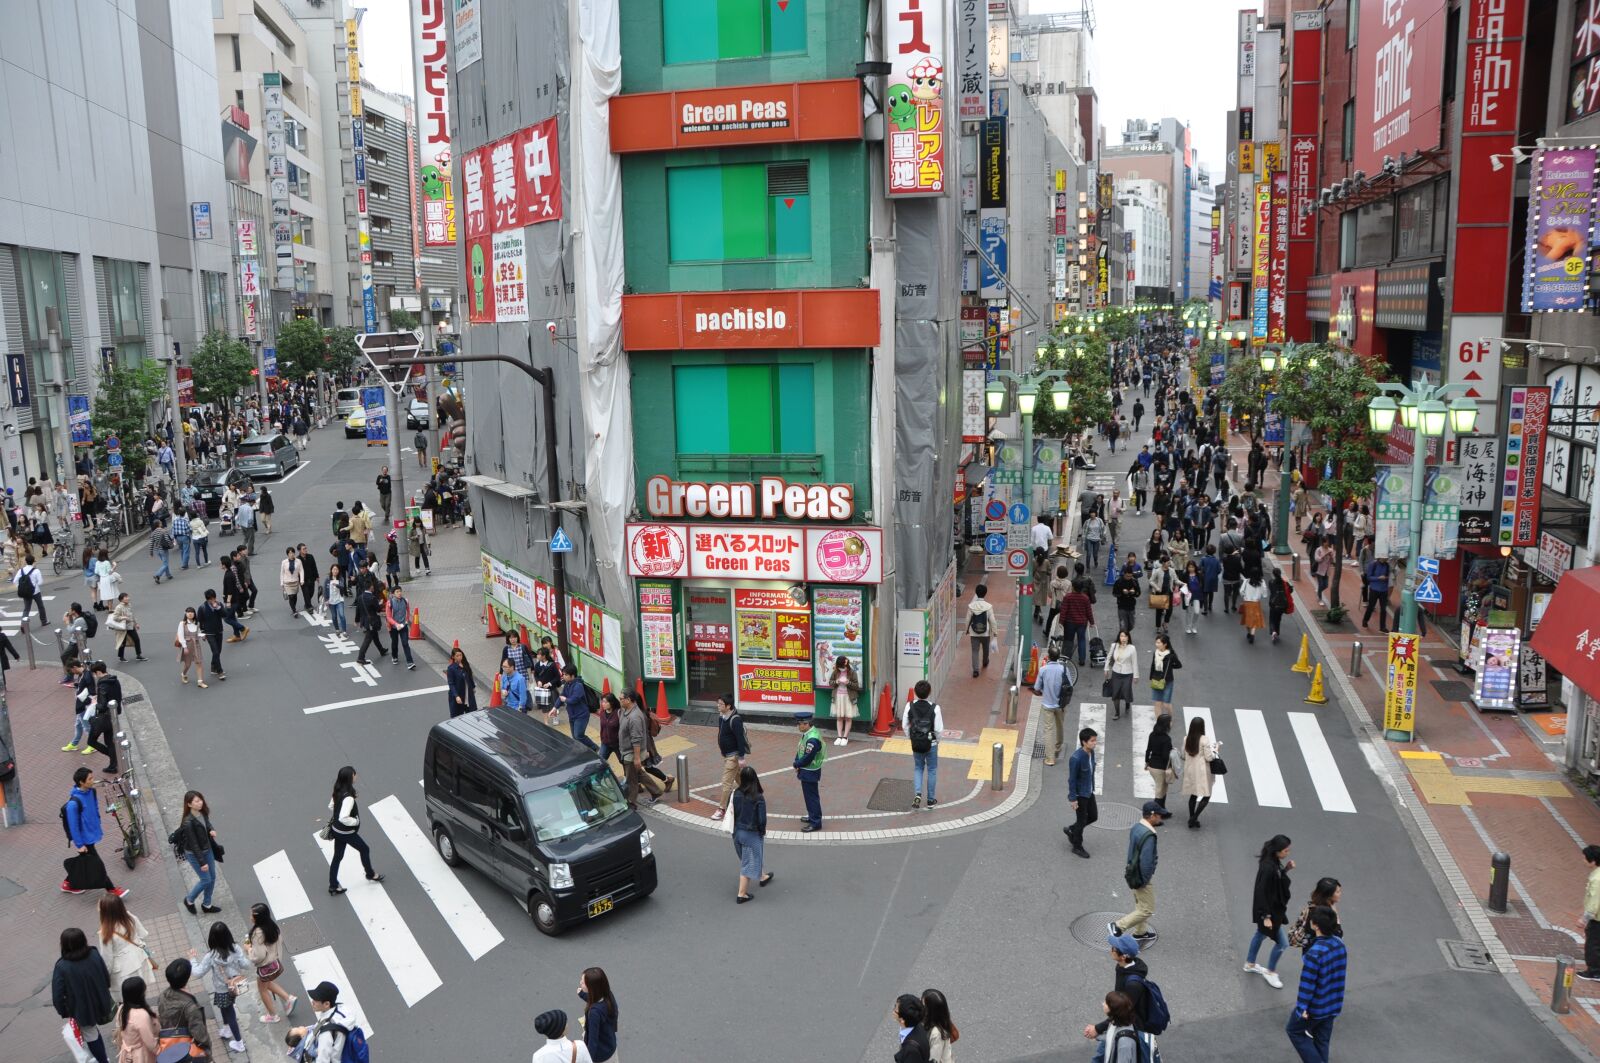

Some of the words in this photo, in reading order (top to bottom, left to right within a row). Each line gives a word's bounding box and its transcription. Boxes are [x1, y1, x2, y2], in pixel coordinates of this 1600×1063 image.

[1470, 46, 1483, 126] STATION
[682, 103, 737, 125] Green
[741, 100, 787, 120] Peas
[683, 125, 711, 133] welcome
[712, 123, 719, 131] to
[721, 121, 749, 131] pachislo
[750, 121, 770, 130] green
[771, 120, 788, 128] peas
[892, 133, 916, 188] 聖地
[464, 130, 553, 214] 営業中
[1566, 262, 1583, 272] 3F
[901, 283, 928, 297] 防音
[695, 308, 787, 333] pachislo
[1458, 341, 1491, 363] 6F
[12, 357, 24, 404] GAP
[1466, 462, 1488, 508] 海神
[646, 475, 756, 518] Green
[761, 476, 854, 520] Peas
[900, 490, 922, 503] 防音
[642, 529, 671, 560] 新
[694, 533, 801, 555] 選べるスロット
[988, 539, 998, 551] P
[705, 554, 749, 571] Green
[755, 557, 791, 573] Peas
[1012, 553, 1025, 564] 30
[777, 614, 809, 623] 全レース
[761, 693, 778, 701] Green
[778, 694, 793, 702] Peas
